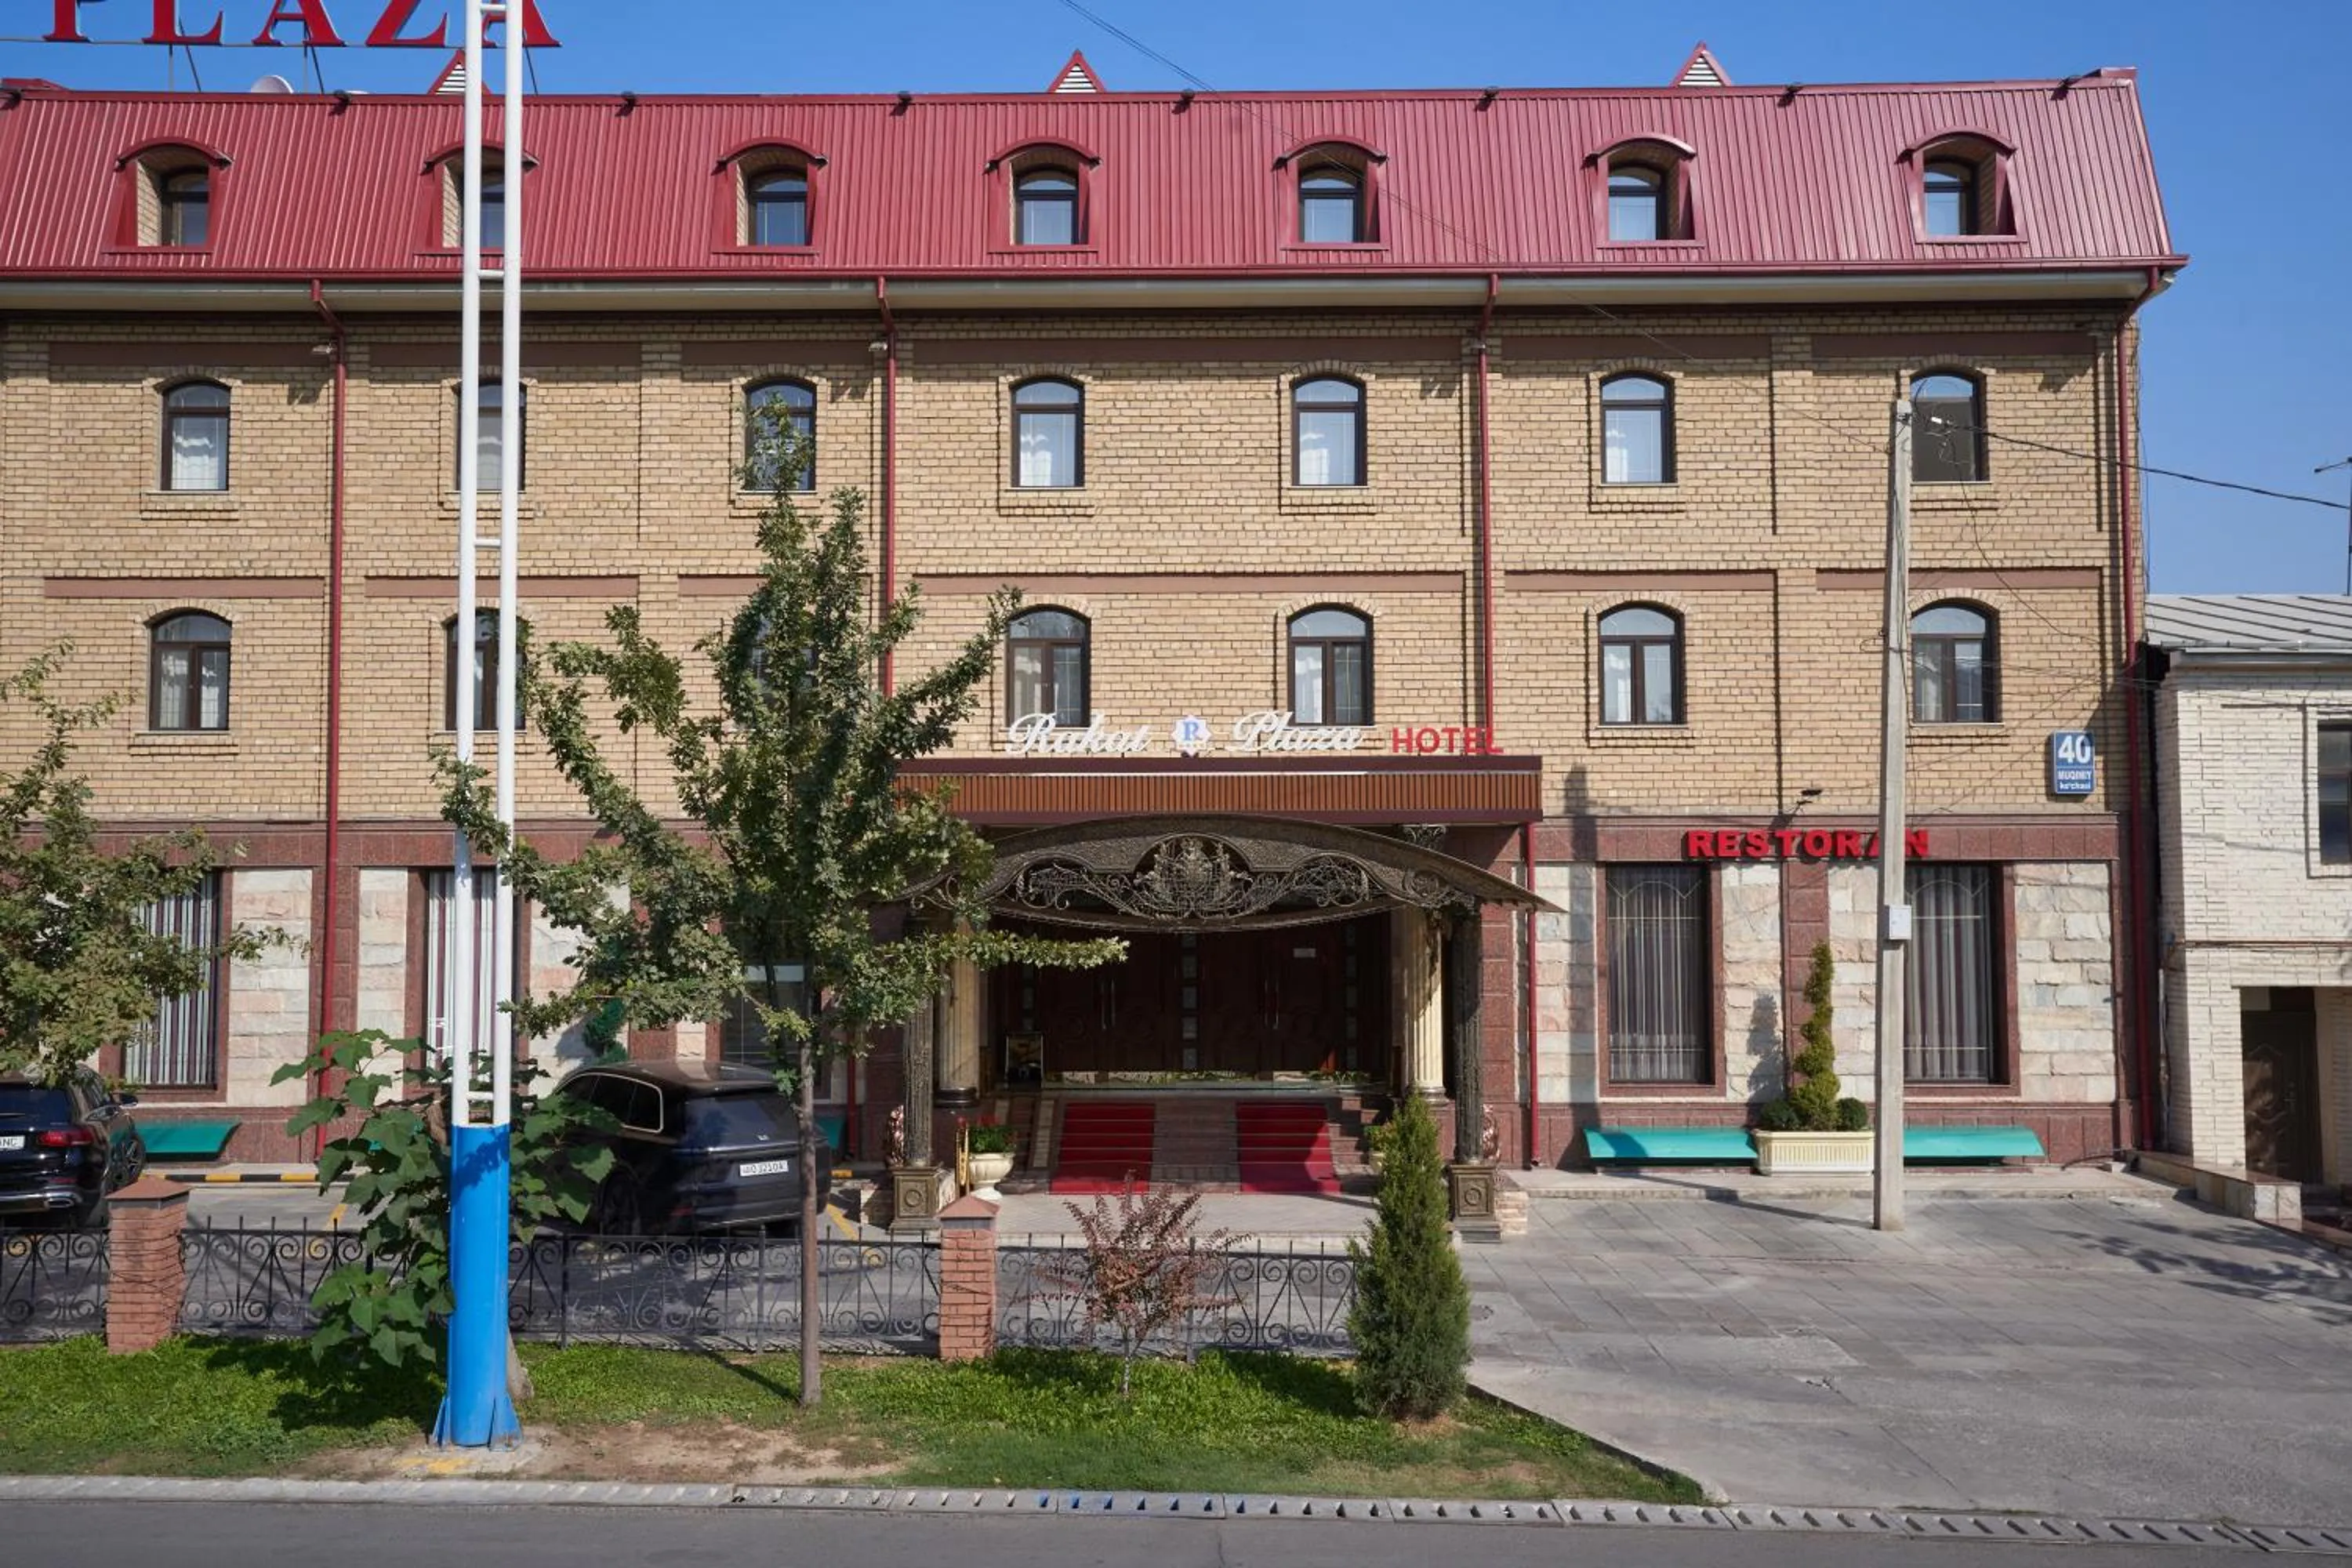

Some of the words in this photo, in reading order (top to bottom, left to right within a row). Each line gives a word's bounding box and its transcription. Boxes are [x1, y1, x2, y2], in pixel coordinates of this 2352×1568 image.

[1225, 710, 1365, 753] Plaza
[1391, 727, 1504, 754] HOTEL
[2057, 735, 2092, 764] 40
